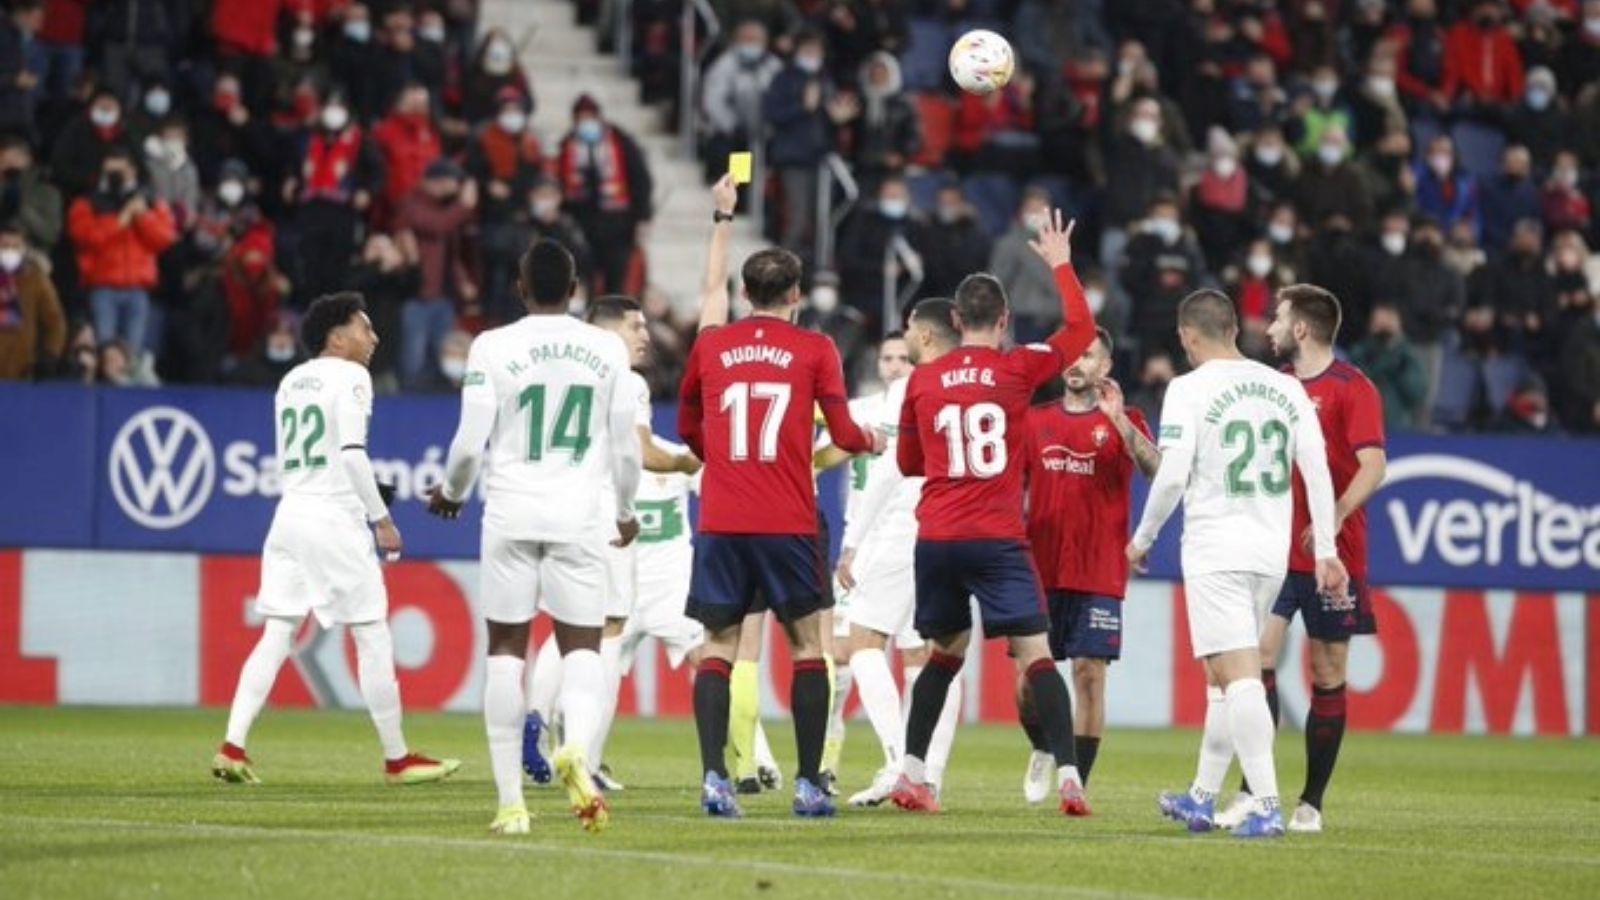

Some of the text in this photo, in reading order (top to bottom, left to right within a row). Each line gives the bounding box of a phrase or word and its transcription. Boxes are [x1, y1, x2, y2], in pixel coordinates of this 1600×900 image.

[506, 343, 611, 379] H. PALACIOS
[720, 344, 794, 369] BUDIMIR
[940, 368, 979, 389] KIKE
[281, 403, 327, 470] 22
[514, 383, 595, 465] 14
[719, 381, 792, 461] 17
[933, 402, 1007, 480] 18
[1220, 419, 1292, 498] 23
